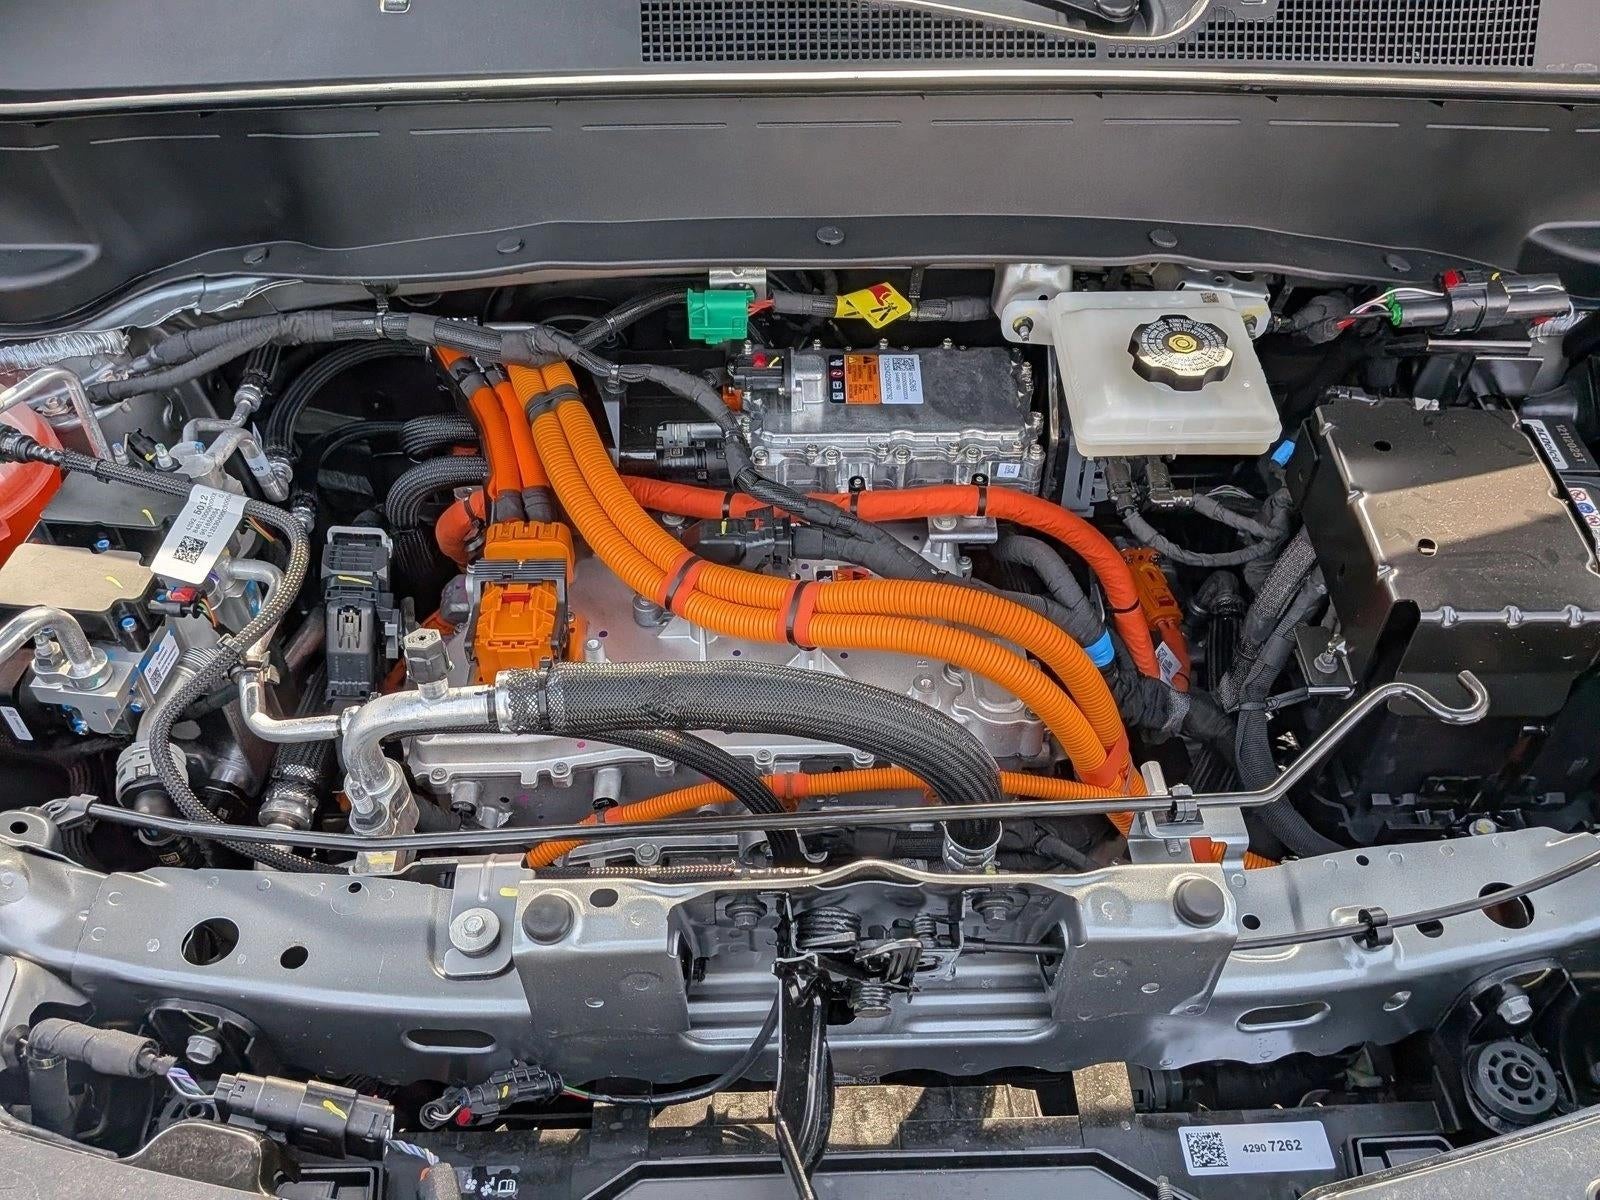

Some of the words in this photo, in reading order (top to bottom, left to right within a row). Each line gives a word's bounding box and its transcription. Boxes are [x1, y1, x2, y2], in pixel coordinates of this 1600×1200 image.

[1534, 426, 1560, 462] ACDelco
[193, 494, 208, 516] 5012
[1242, 1143, 1267, 1153] 4290
[1267, 1139, 1302, 1152] 7262
